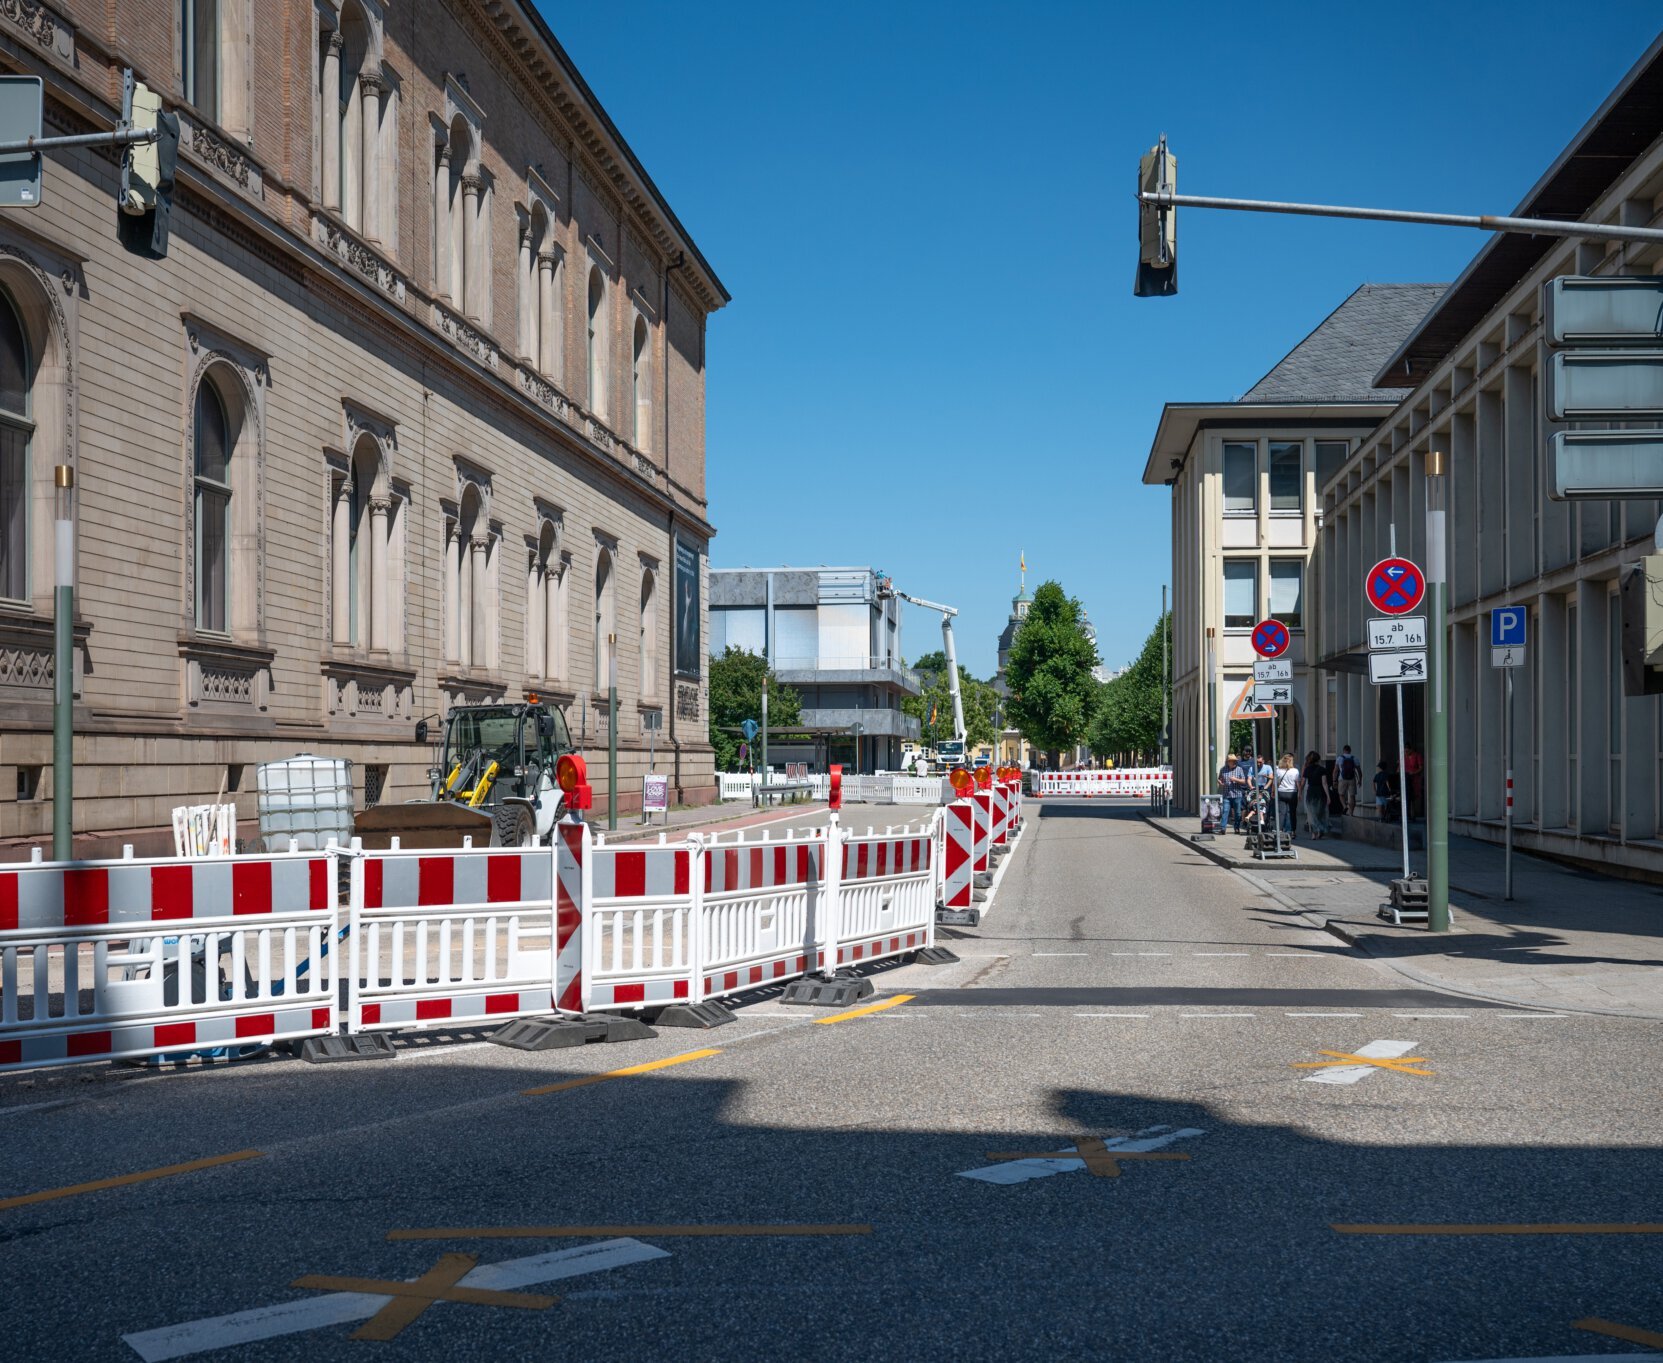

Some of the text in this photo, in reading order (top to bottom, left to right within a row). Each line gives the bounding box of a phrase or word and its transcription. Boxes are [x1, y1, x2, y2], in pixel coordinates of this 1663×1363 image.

[1391, 622, 1404, 631] ab
[1500, 613, 1517, 640] P
[1374, 634, 1394, 644] 15.7.
